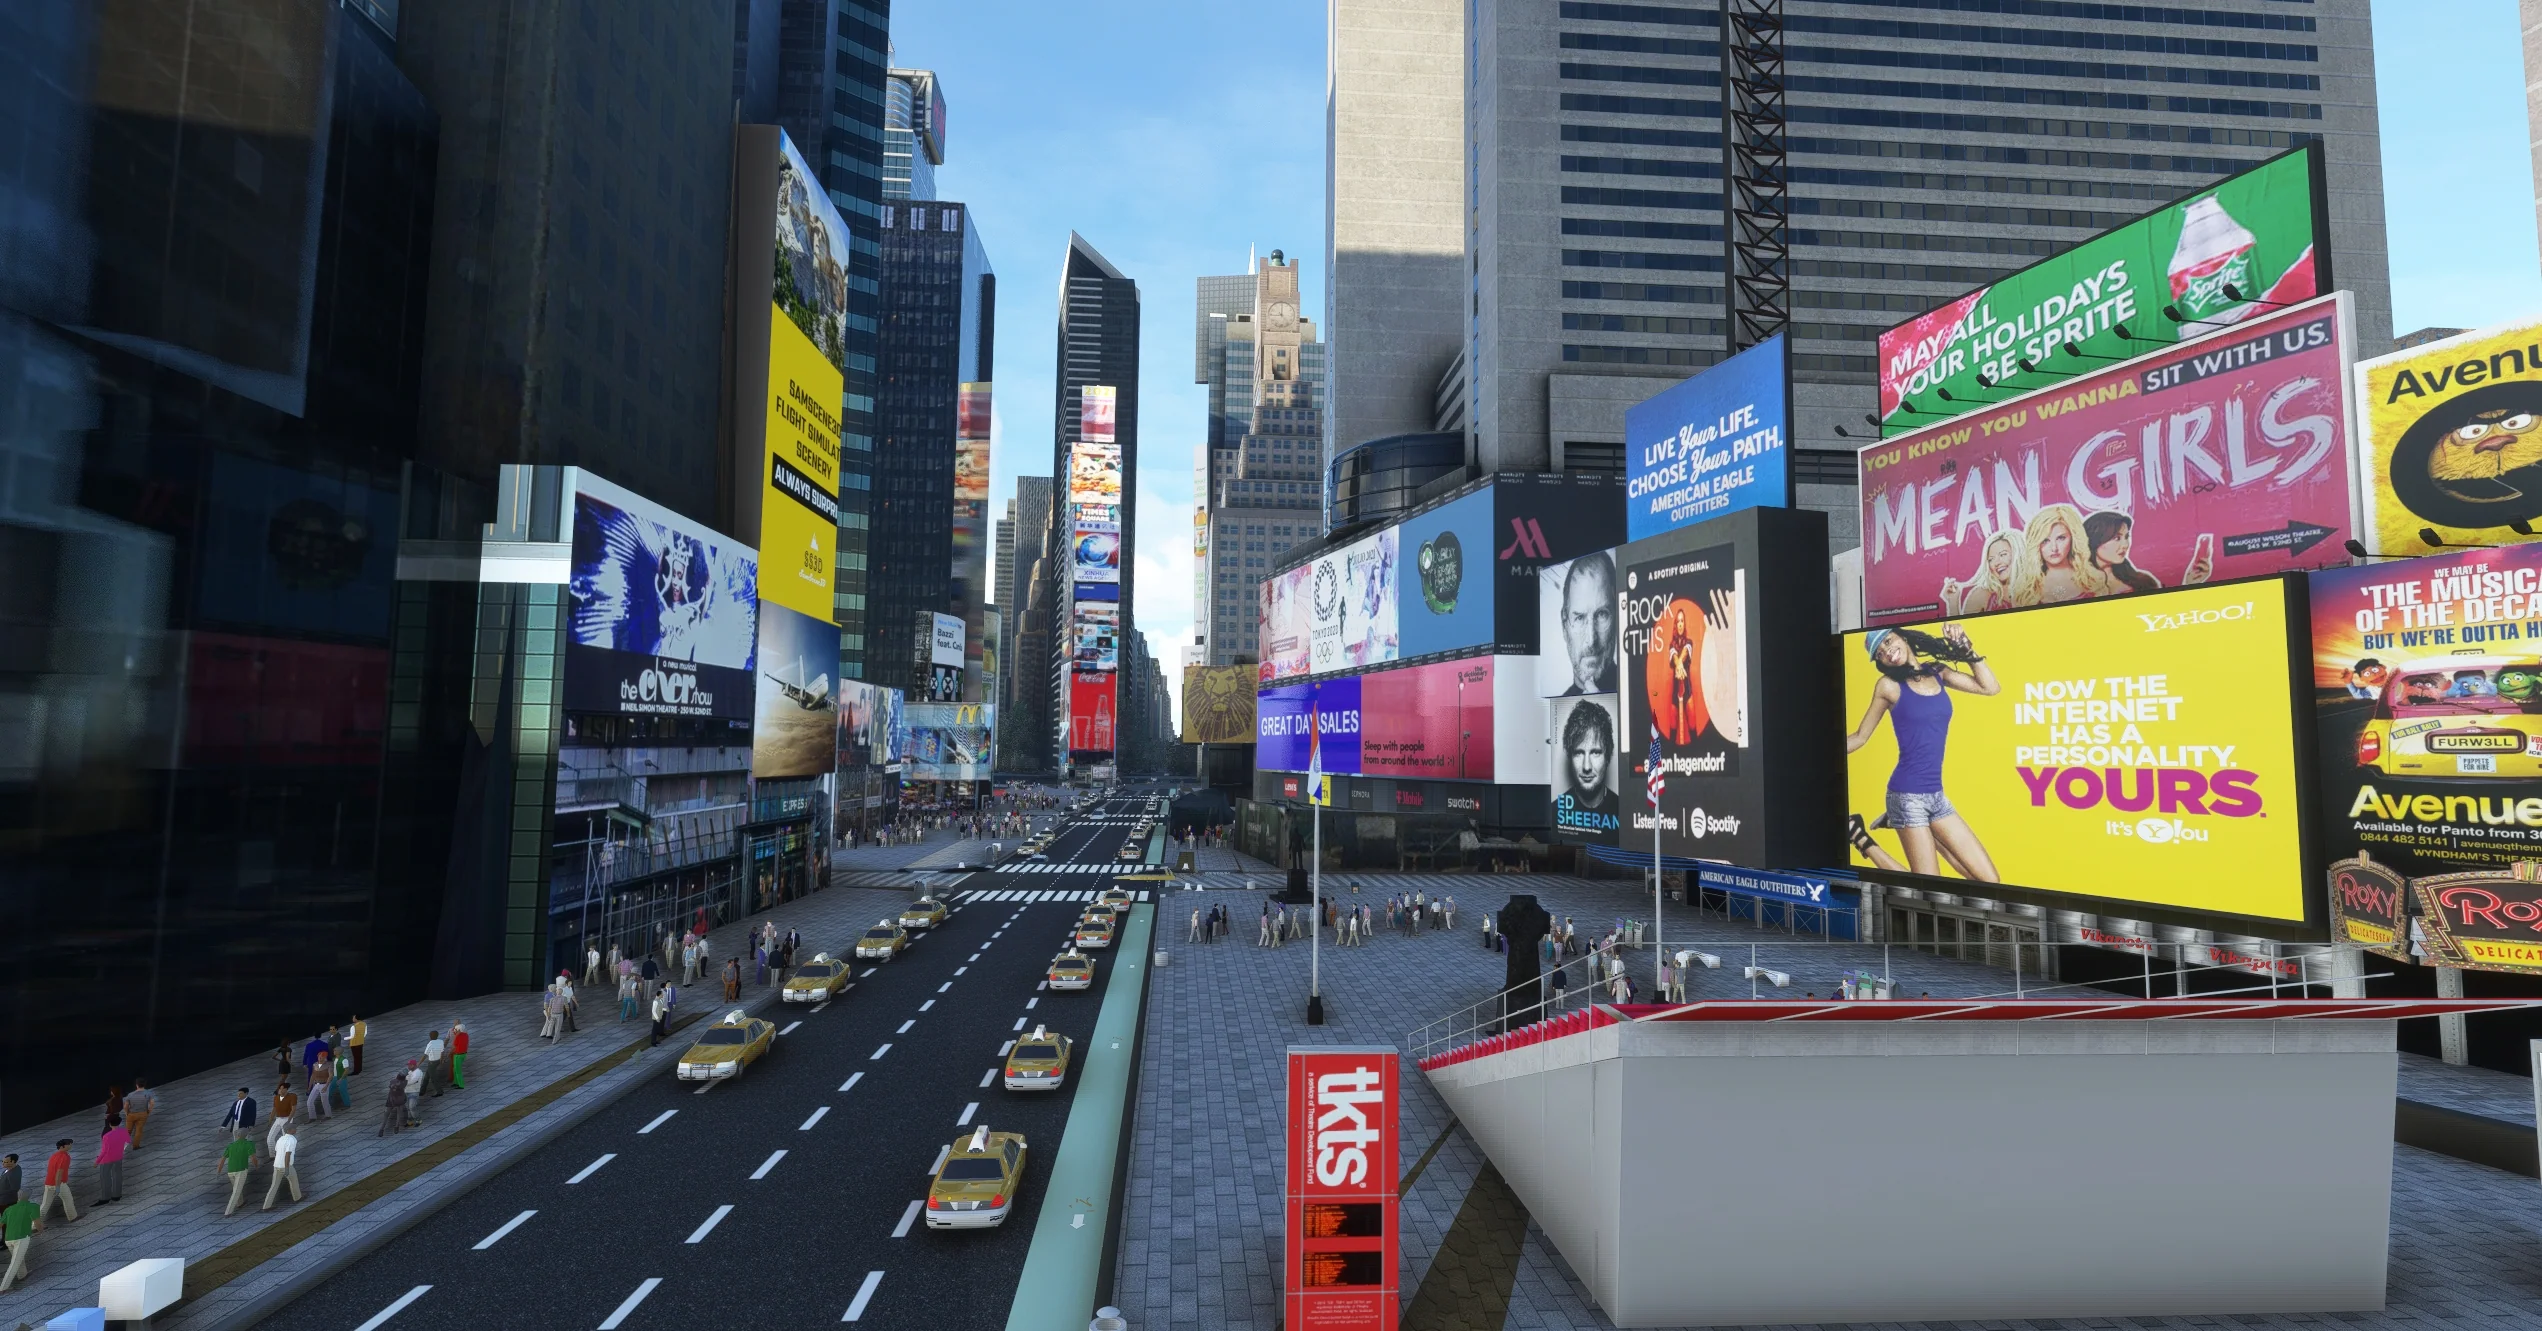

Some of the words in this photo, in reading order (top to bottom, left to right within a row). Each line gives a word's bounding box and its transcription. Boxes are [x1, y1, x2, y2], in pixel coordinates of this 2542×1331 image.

[1890, 328, 1944, 379] MAY
[1948, 304, 1997, 347] ALL
[1893, 350, 1966, 396] YOUR
[1972, 260, 2129, 364] HOLIDAYS
[1980, 351, 2018, 389] BE
[2024, 287, 2137, 368] SPRITE
[2146, 360, 2191, 390] SIT
[2197, 338, 2271, 377] WITH
[2283, 322, 2329, 353] US.
[776, 395, 807, 434] FLIGHT
[1864, 451, 1902, 473] YOU
[1908, 428, 1971, 460] KNOW
[1980, 410, 2027, 436] YOU
[2036, 378, 2139, 421] WANNA
[1645, 436, 1676, 467] LIVE
[1678, 423, 1718, 459] Your
[1719, 404, 1759, 439] LIFE.
[796, 440, 832, 480] SCENERY
[1628, 460, 1687, 499] CHOOSE
[1690, 447, 1731, 483] Your
[1733, 425, 1783, 463] PATH.
[1872, 448, 2042, 564] MEAN
[2065, 377, 2338, 516] GIRLS
[774, 463, 811, 501] ALWAYS
[1650, 482, 1709, 515] AMERICAN
[1713, 465, 1754, 495] EAGLE
[1671, 493, 1729, 522] OUTFITTERS
[1648, 572, 1653, 581] A
[1654, 565, 1678, 580] SPOTIFY
[1679, 559, 1710, 575] ORIGINAL
[2434, 568, 2449, 578] WE
[2452, 565, 2473, 576] MAY
[2477, 563, 2489, 573] BE
[2431, 567, 2542, 603] MUSIC
[1629, 593, 1674, 626] ROCK
[2136, 602, 2254, 633] YAHOO!
[2356, 608, 2389, 633] OF
[2401, 602, 2455, 629] THE
[937, 628, 954, 638] Bazzi
[937, 639, 952, 649] feat.
[1312, 627, 1327, 640] TOKYO
[1327, 624, 1338, 637] 2020
[1628, 627, 1664, 655] THIS
[2364, 633, 2394, 650] BUT
[2401, 628, 2455, 647] WE'RE
[2462, 623, 2520, 643] OUTTA
[668, 661, 679, 669] new
[679, 662, 697, 672] musical
[620, 679, 638, 700] the
[639, 656, 696, 704] cher
[691, 687, 713, 705] show
[2024, 678, 2096, 701] NOW
[2104, 674, 2167, 697] THE
[625, 702, 638, 712] NEIL
[639, 703, 656, 713] SIMON
[656, 704, 677, 714] THEATRE
[2015, 696, 2183, 725] INTERNET
[1261, 715, 1292, 736] GREAT
[1320, 710, 1359, 734] SALES
[2050, 724, 2111, 745] HAS
[2120, 723, 2144, 744] A
[1364, 740, 1381, 753] Sleep
[1383, 740, 1398, 750] with
[1400, 740, 1425, 754] people
[2438, 735, 2512, 747] FURW3LL
[1364, 754, 1379, 765] from
[1381, 755, 1406, 766] around
[1407, 754, 1419, 766] the
[1421, 755, 1445, 767] world
[1673, 751, 1725, 776] hagendorf
[2015, 745, 2237, 767] PERSONALITY.
[1351, 790, 1370, 798] SEPHORA
[1447, 798, 1475, 810] swatch
[1557, 793, 1574, 809] ED
[2015, 766, 2267, 818] YOURS.
[1557, 810, 1619, 830] SHEERAN
[1659, 813, 1678, 830] Free
[1707, 815, 1738, 835] Spotify
[2106, 820, 2133, 838] It's
[2354, 821, 2414, 833] Available
[2417, 823, 2437, 835] for
[2442, 825, 2485, 837] Panto
[2488, 828, 2525, 839] from
[2360, 833, 2389, 843] 0844
[2394, 834, 2415, 845] 482
[2418, 836, 2448, 846] 5141
[2413, 849, 2490, 861] WYNDHAM'S
[1700, 870, 1734, 885] AMERICAN
[1736, 876, 1758, 889] EAGLE
[1760, 880, 1806, 897] OUTFITTERS
[2337, 873, 2396, 918] ROXY
[2350, 924, 2391, 943] DELICATESSEN
[1316, 1066, 1383, 1187] tkts
[1307, 1132, 1315, 1168] Development
[1307, 1169, 1315, 1185] Fund
